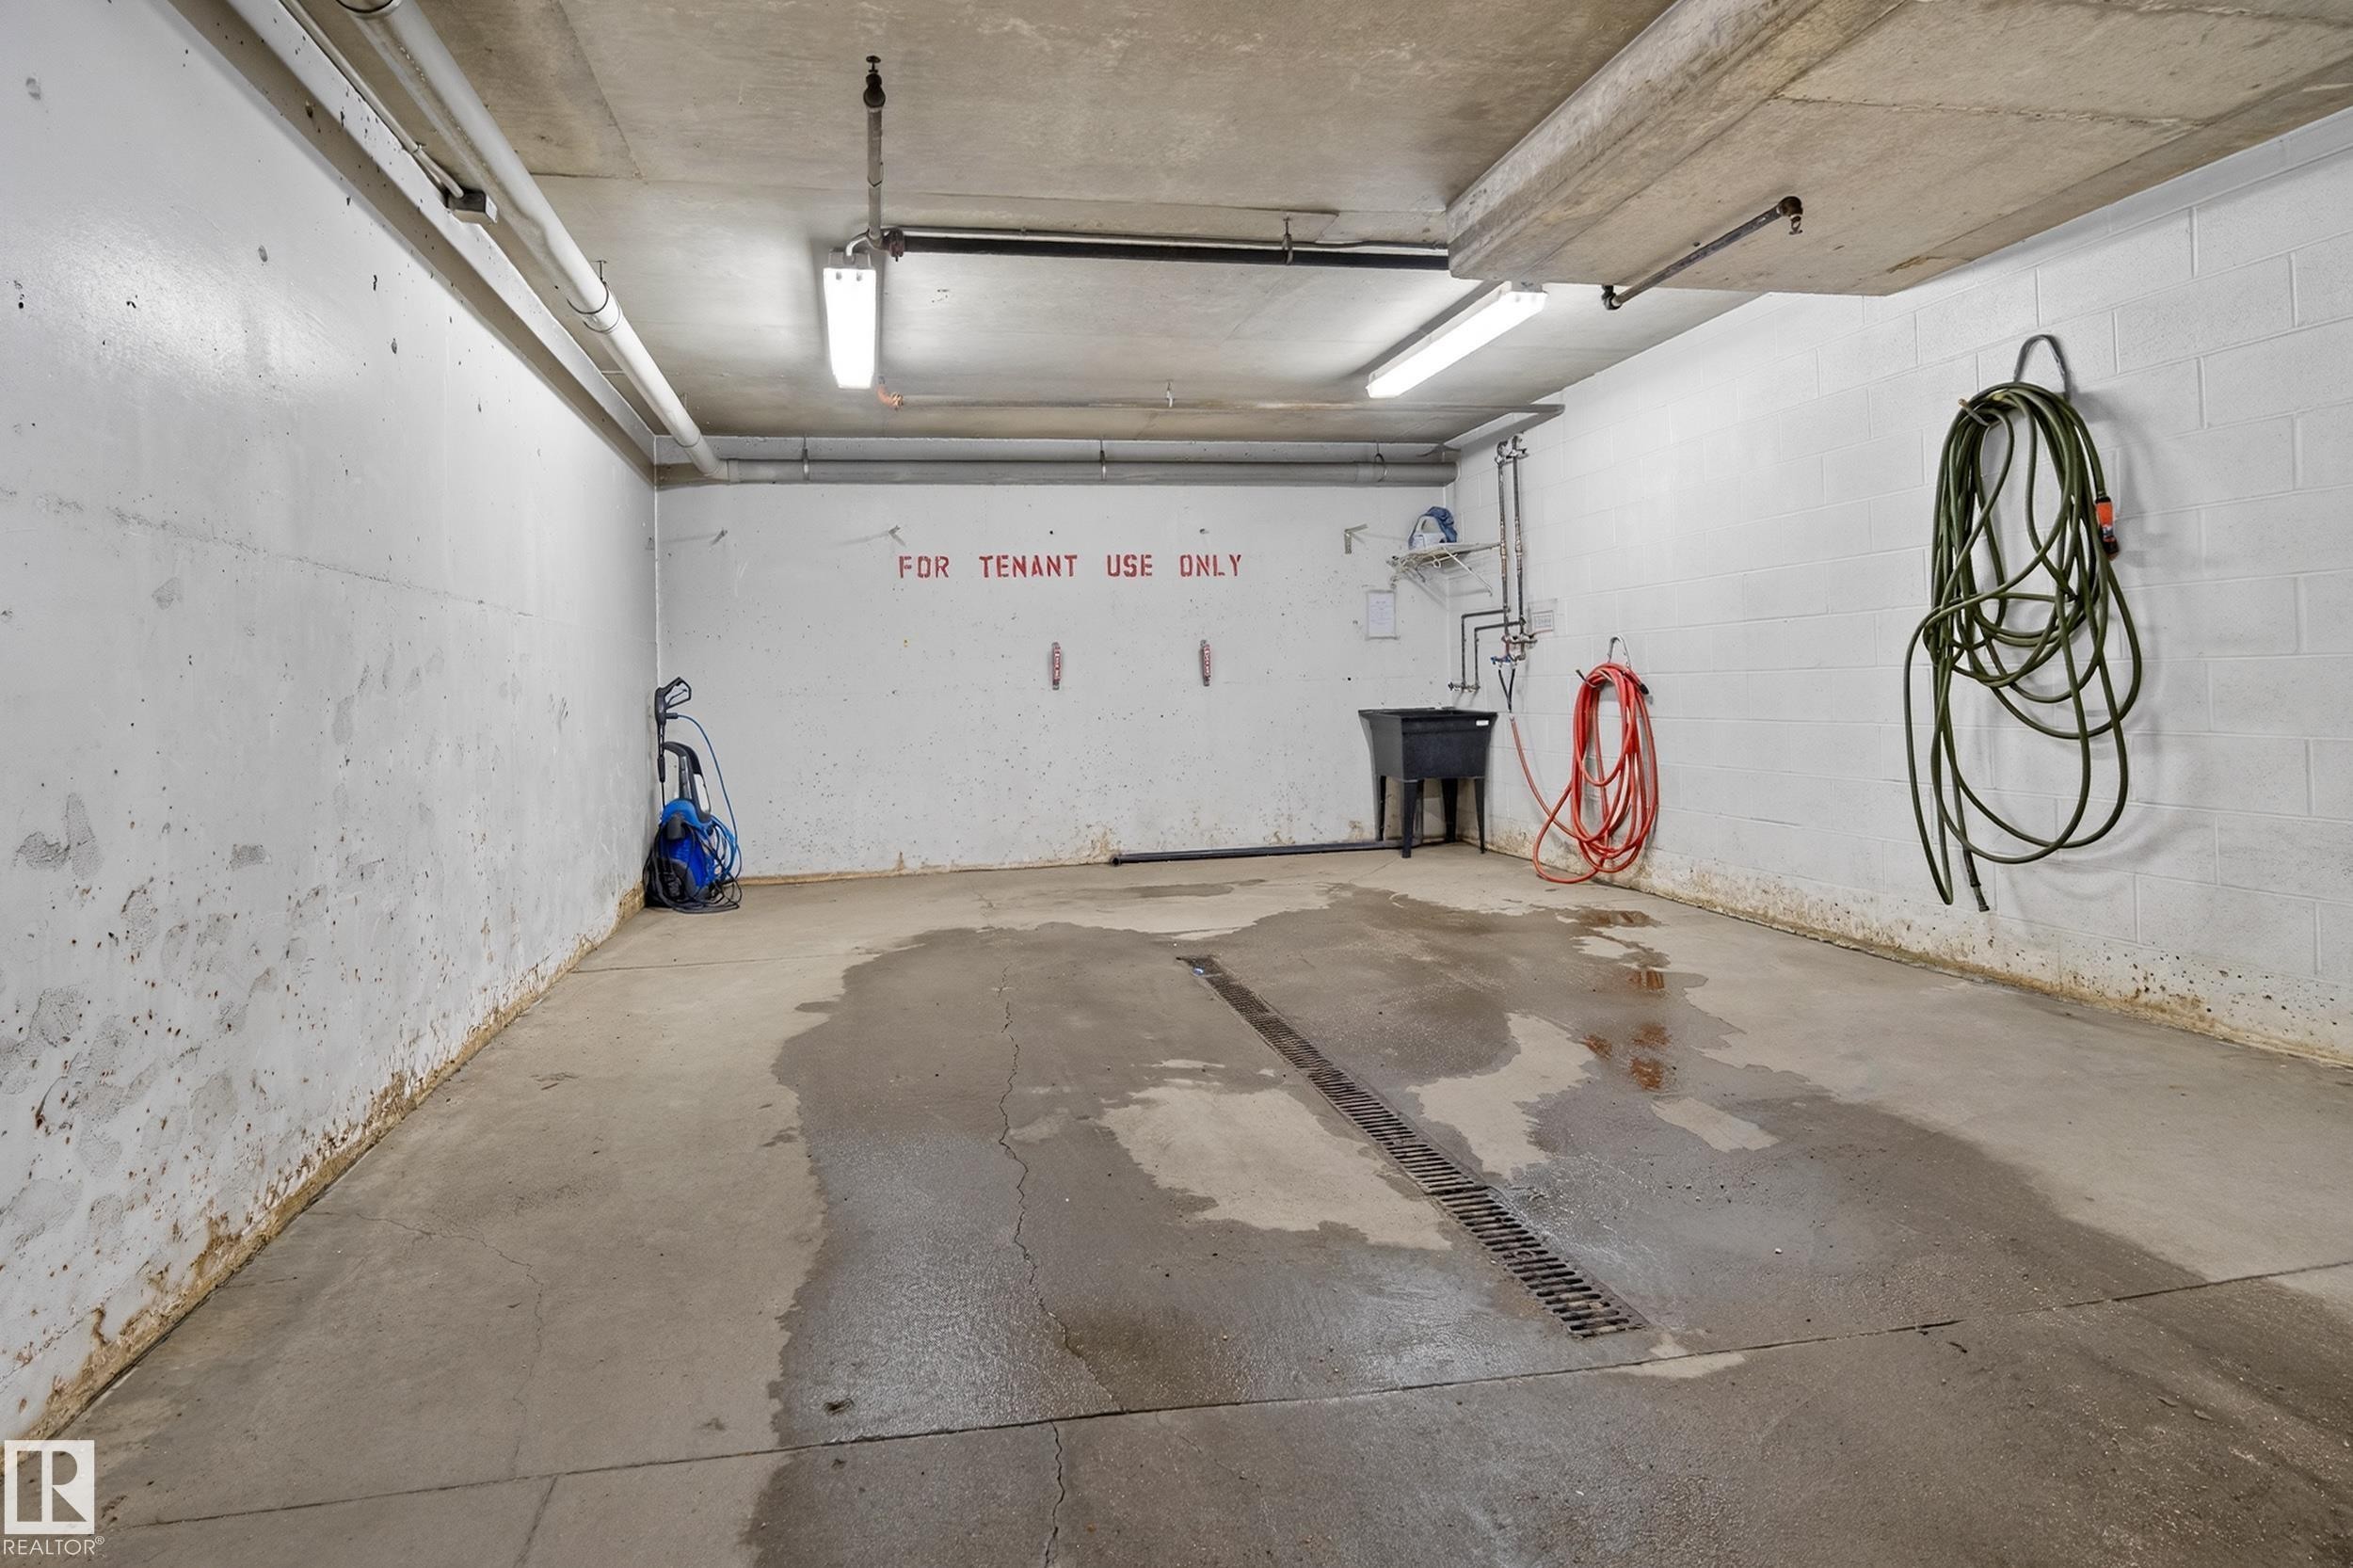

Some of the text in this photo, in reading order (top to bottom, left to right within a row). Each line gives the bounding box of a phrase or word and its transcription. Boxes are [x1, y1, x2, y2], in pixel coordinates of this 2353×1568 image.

[898, 554, 1242, 578] FOR TENANT USE ONLY
